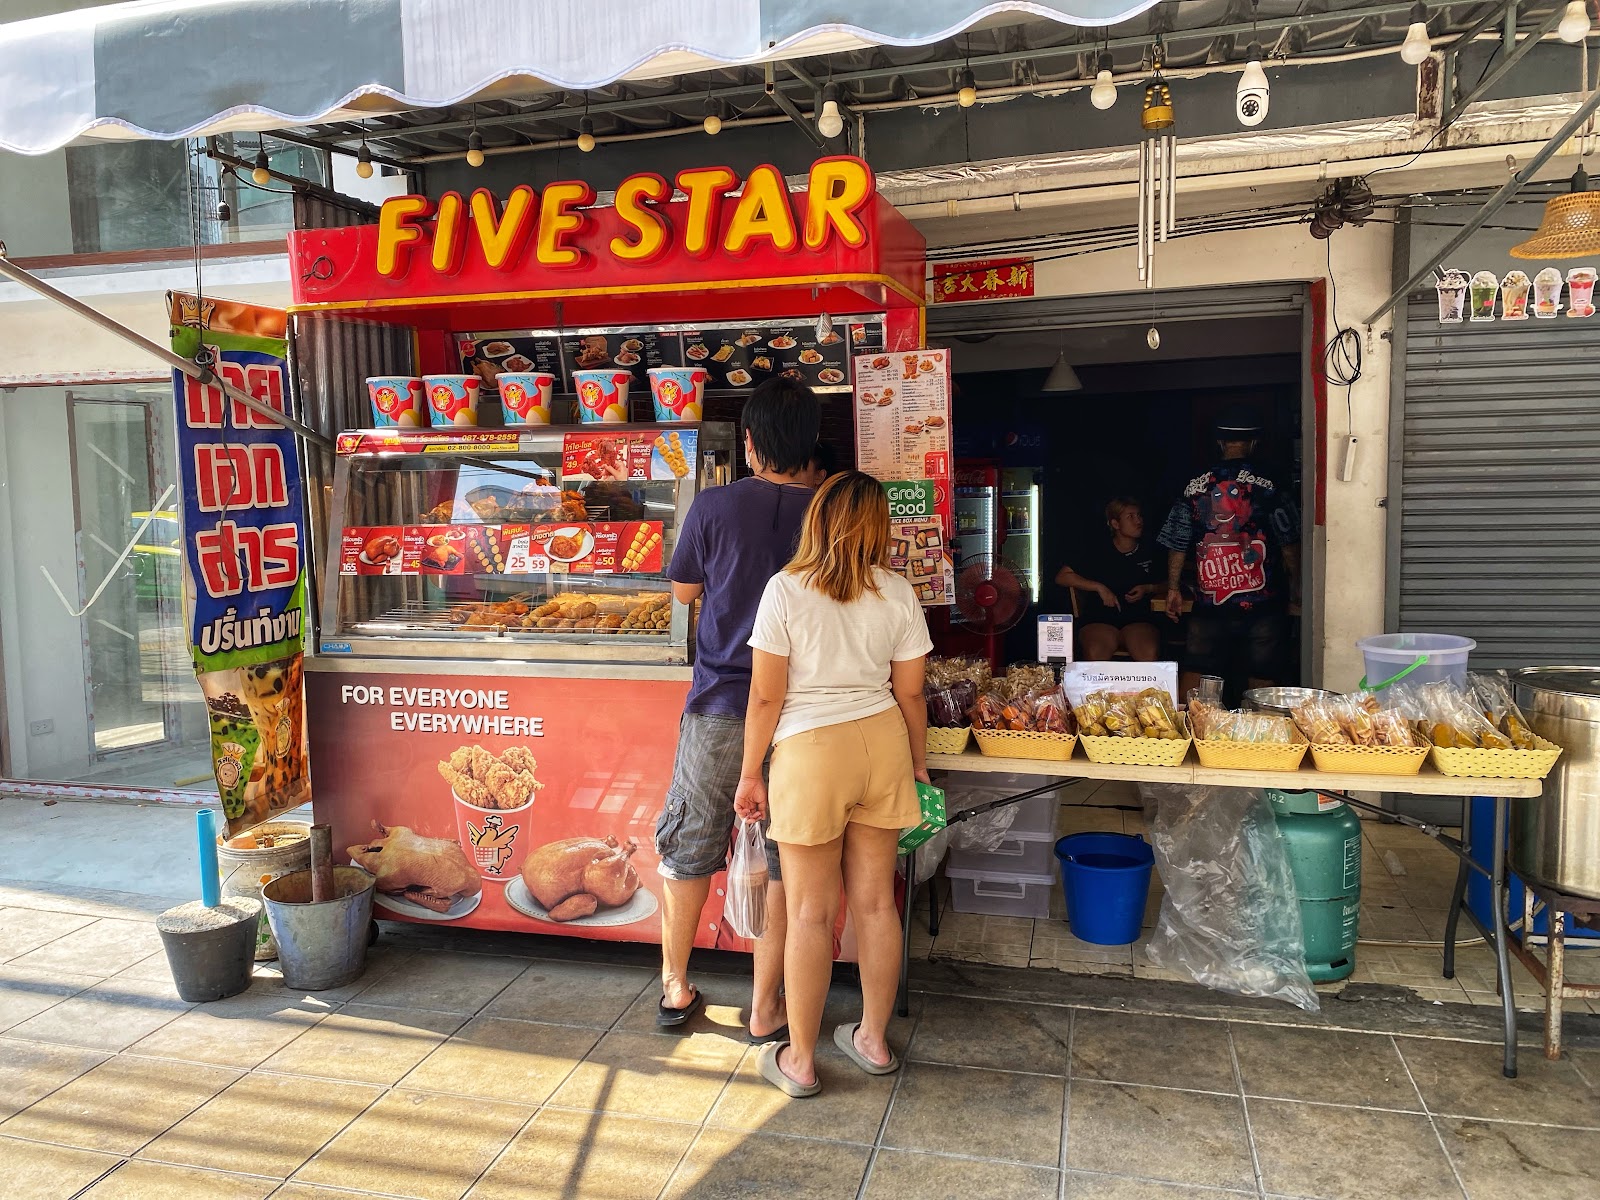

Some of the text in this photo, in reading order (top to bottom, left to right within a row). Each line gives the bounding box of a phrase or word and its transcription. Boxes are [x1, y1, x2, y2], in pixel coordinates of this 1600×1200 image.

[376, 156, 875, 278] FIVE STAR
[194, 443, 289, 512] เอก
[887, 484, 926, 500] Grab
[888, 500, 926, 515] Food
[196, 520, 299, 598] สาร
[511, 556, 526, 568] 25
[532, 559, 545, 569] 59
[341, 685, 509, 709] FOR EVERYONE
[390, 712, 544, 736] EVERYWHERE
[1267, 792, 1285, 804] 16.2
